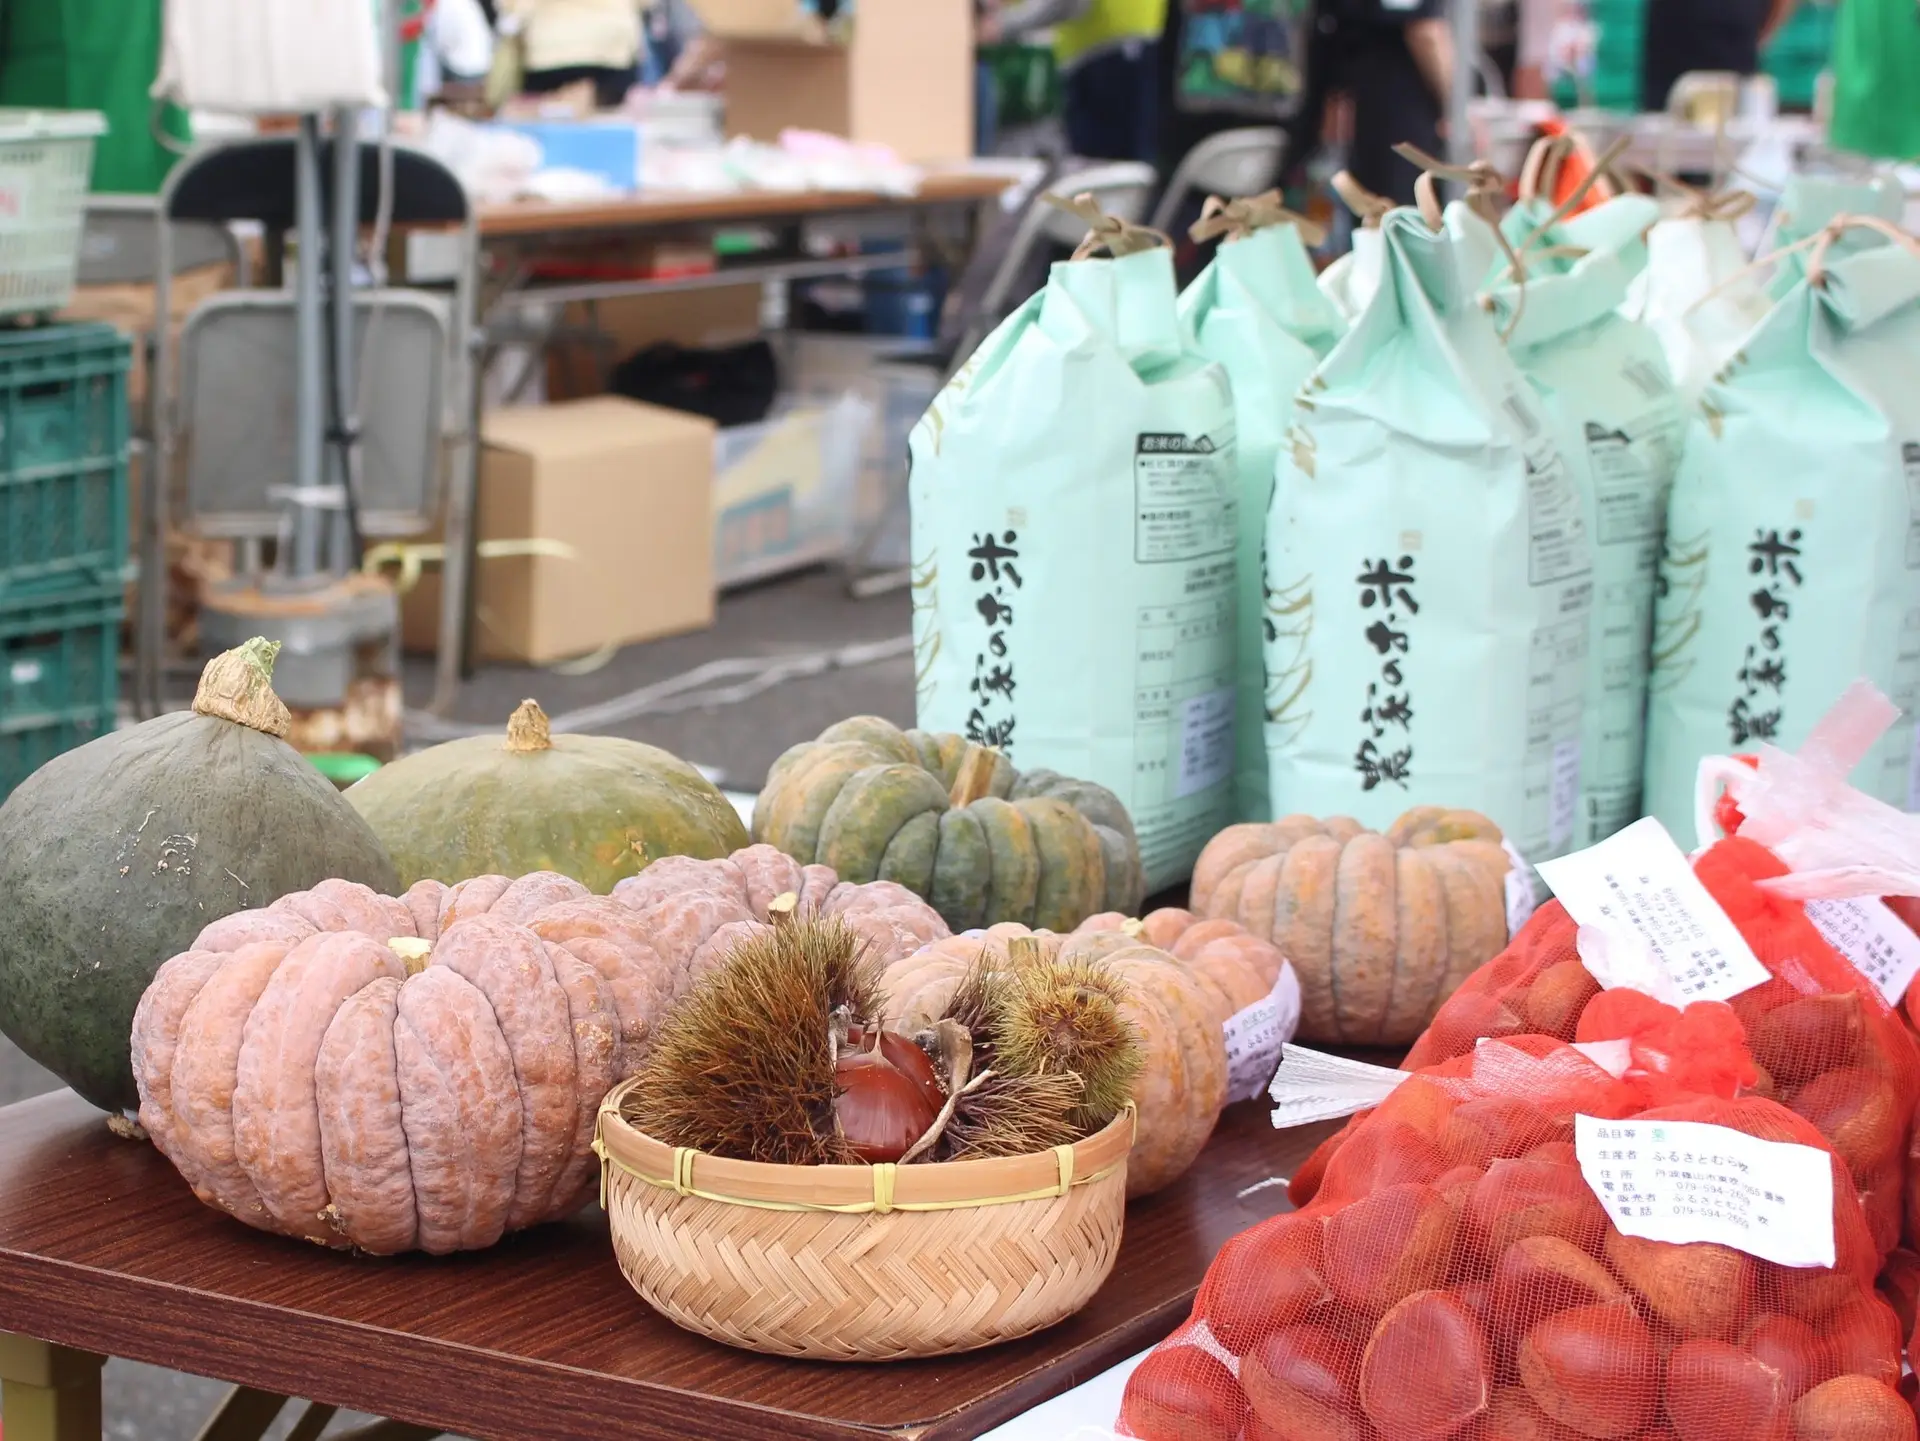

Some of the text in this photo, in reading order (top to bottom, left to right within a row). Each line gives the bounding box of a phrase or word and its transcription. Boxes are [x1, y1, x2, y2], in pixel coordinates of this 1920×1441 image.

[966, 530, 1023, 759] 農家のお米
[1355, 555, 1420, 791] 農家のお米
[1727, 528, 1803, 747] 農家のお米
[1597, 1128, 1637, 1140] 品目等
[1598, 1150, 1638, 1161] 生産者
